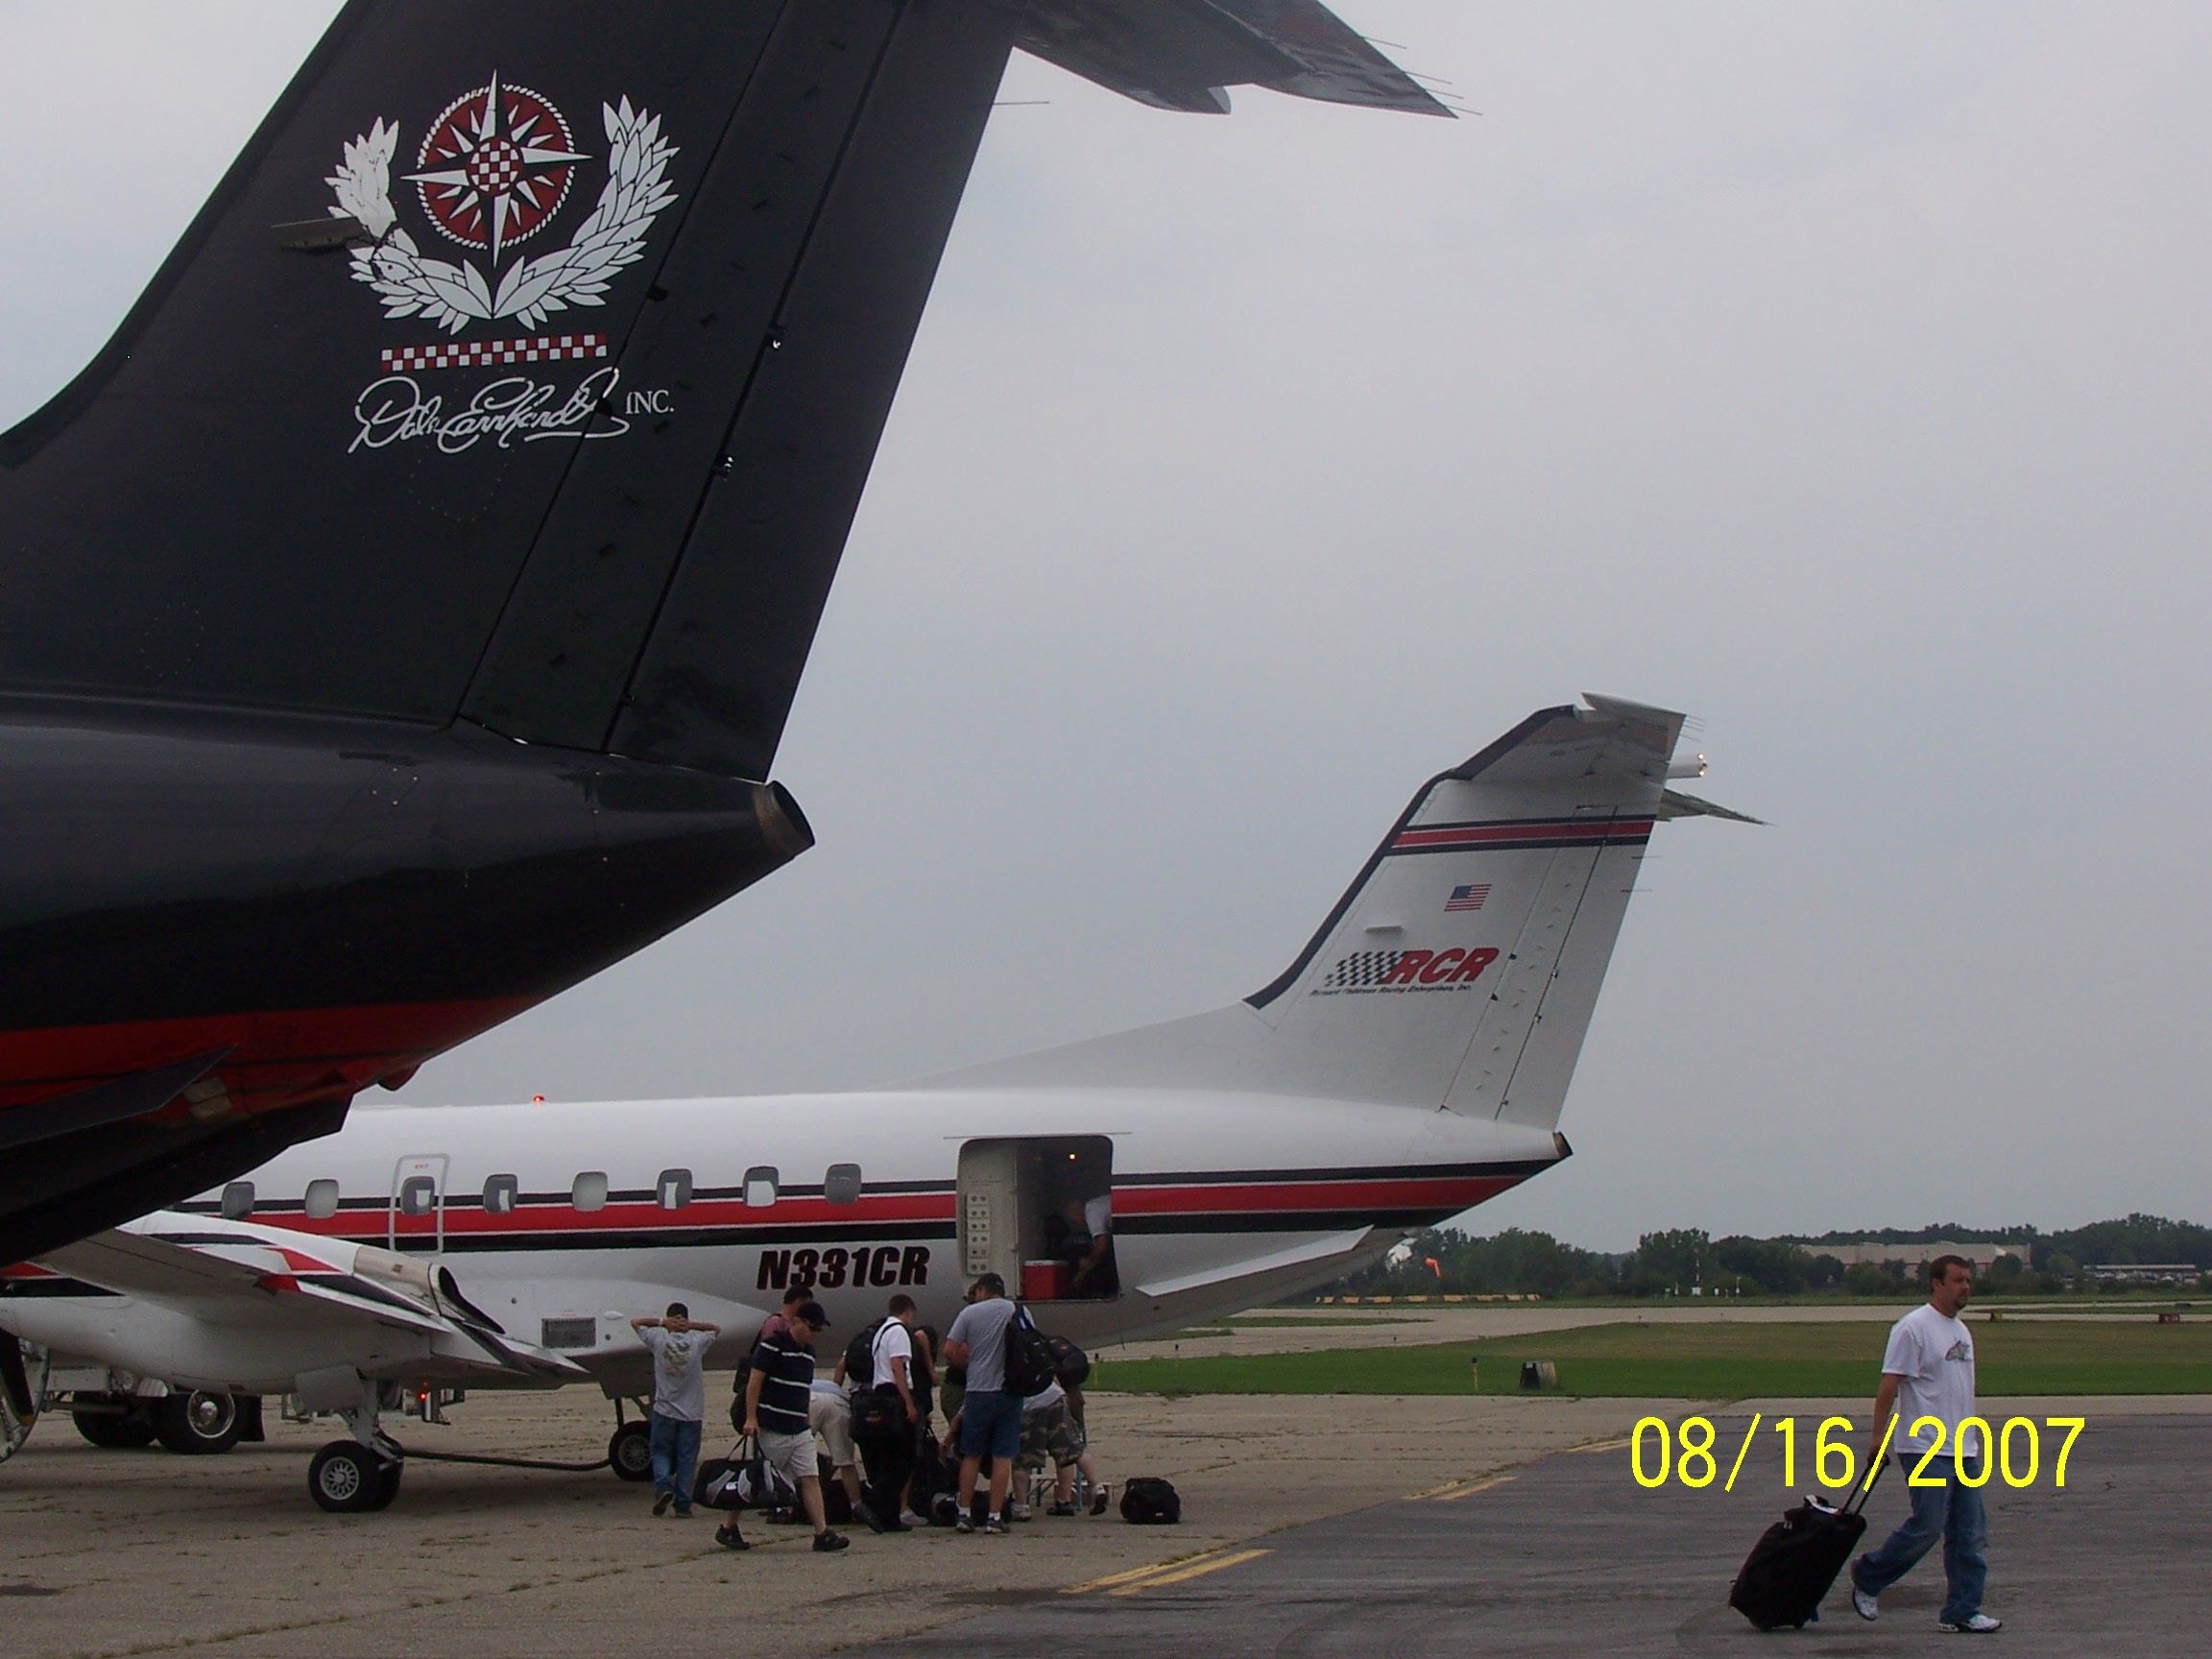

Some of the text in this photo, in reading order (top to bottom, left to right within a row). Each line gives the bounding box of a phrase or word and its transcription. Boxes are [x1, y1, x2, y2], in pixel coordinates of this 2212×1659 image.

[625, 390, 675, 416] INC.
[1381, 947, 1500, 985] RCR
[757, 1246, 930, 1290] N331CR
